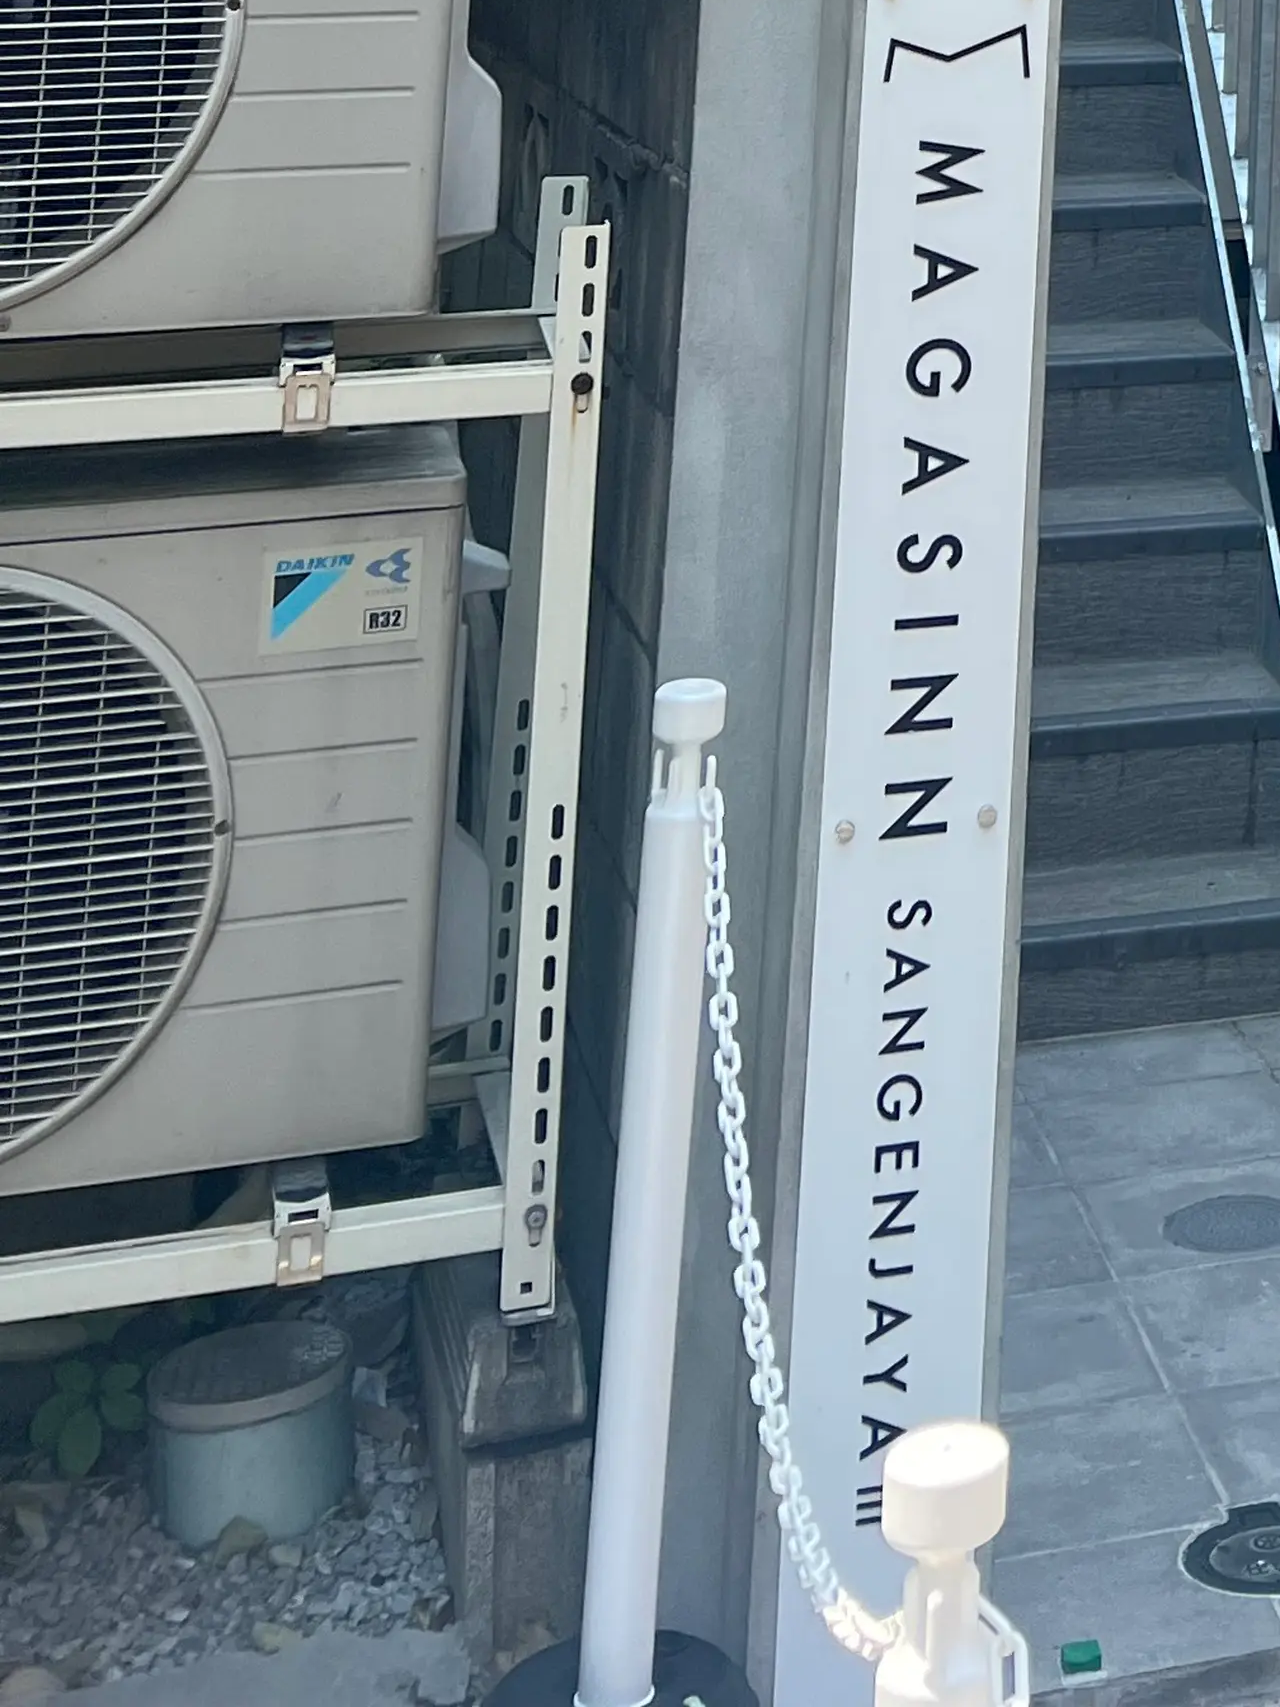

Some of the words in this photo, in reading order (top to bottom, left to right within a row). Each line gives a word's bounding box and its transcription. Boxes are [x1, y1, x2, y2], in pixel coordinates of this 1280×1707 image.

[276, 553, 355, 573] DAIKIN
[368, 609, 402, 630] R32
[878, 139, 986, 842] MAGASINN
[859, 897, 933, 1461] SANGENJAYA
